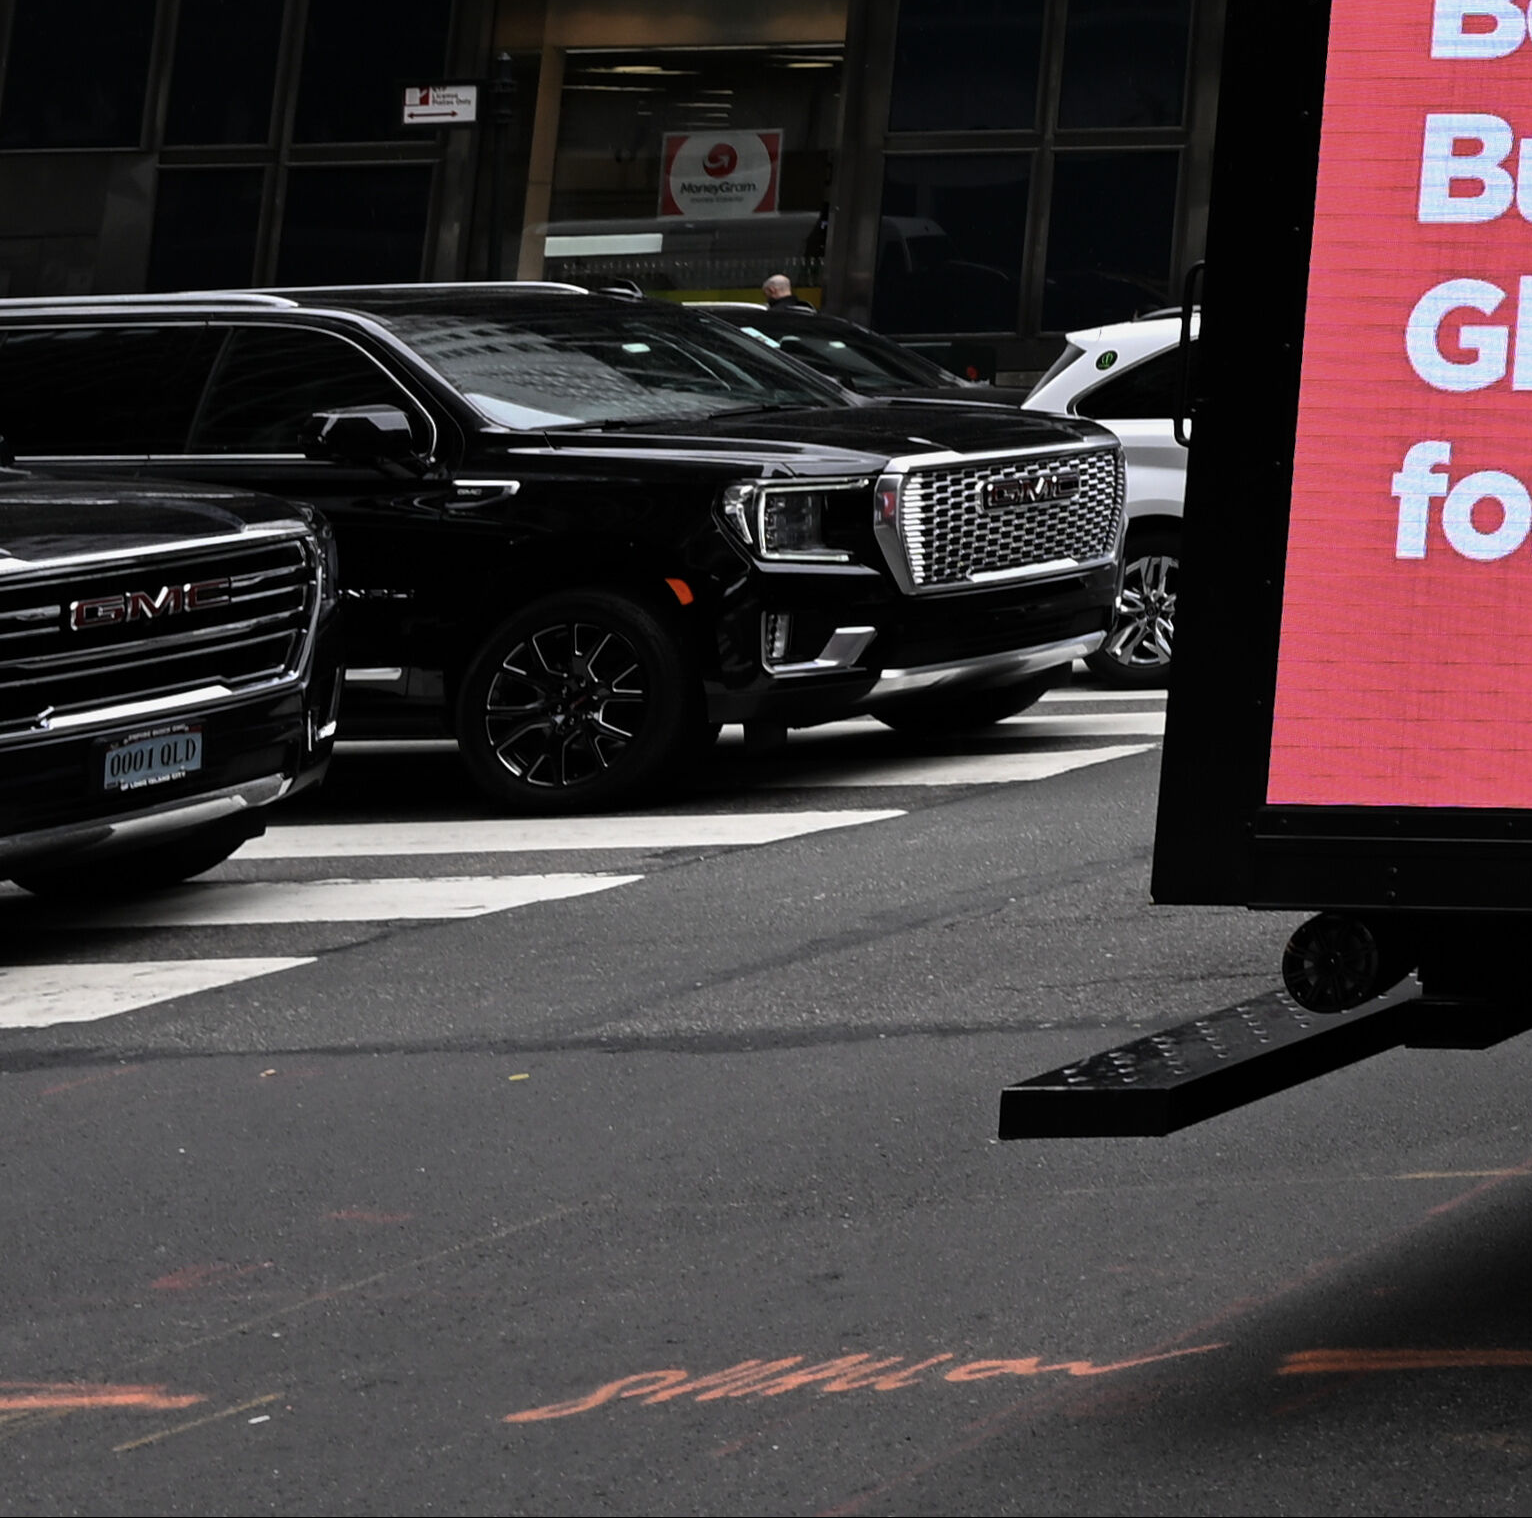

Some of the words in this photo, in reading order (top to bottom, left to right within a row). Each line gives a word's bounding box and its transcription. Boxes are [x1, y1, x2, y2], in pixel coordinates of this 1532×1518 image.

[680, 181, 757, 195] MoneyGram
[987, 472, 1080, 507] GMC
[70, 578, 230, 631] GMC
[110, 747, 153, 778] 0001
[160, 738, 197, 767] QLD
